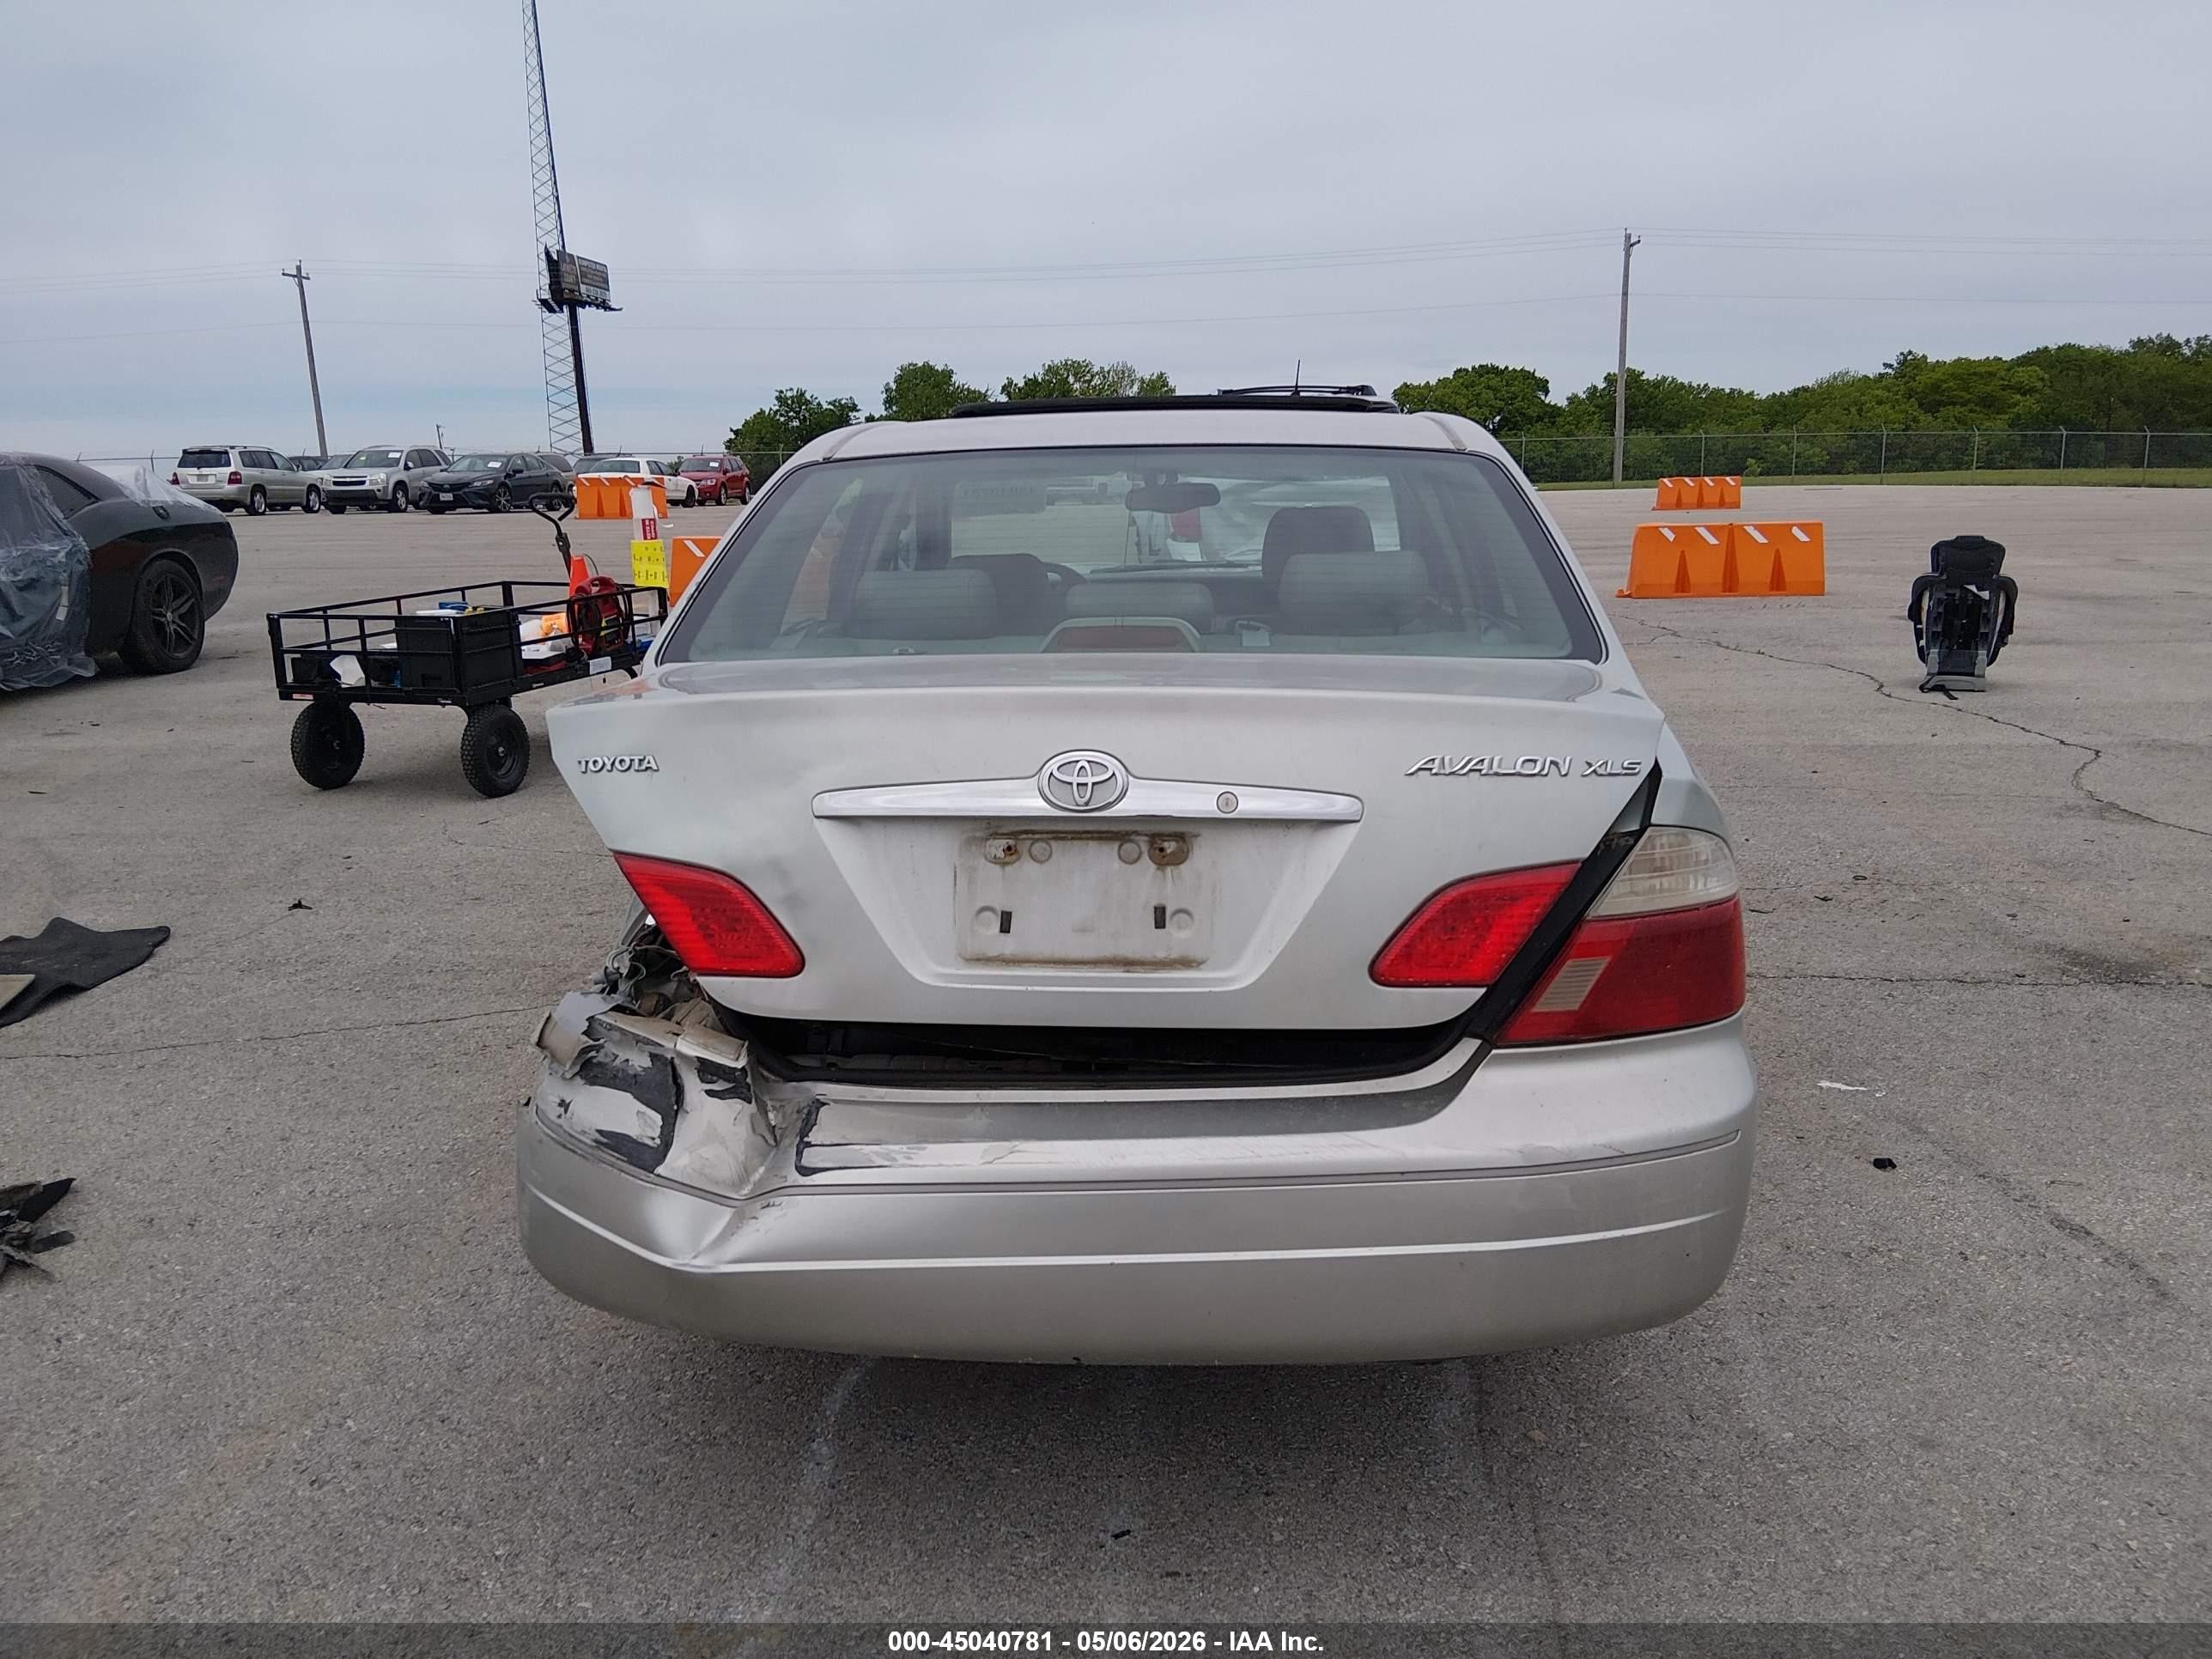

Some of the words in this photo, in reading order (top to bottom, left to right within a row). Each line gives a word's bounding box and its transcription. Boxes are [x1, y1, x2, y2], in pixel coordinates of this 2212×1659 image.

[577, 755, 659, 774] TOYOTA
[1404, 756, 1571, 776] AVALON
[1581, 759, 1643, 776] XLS
